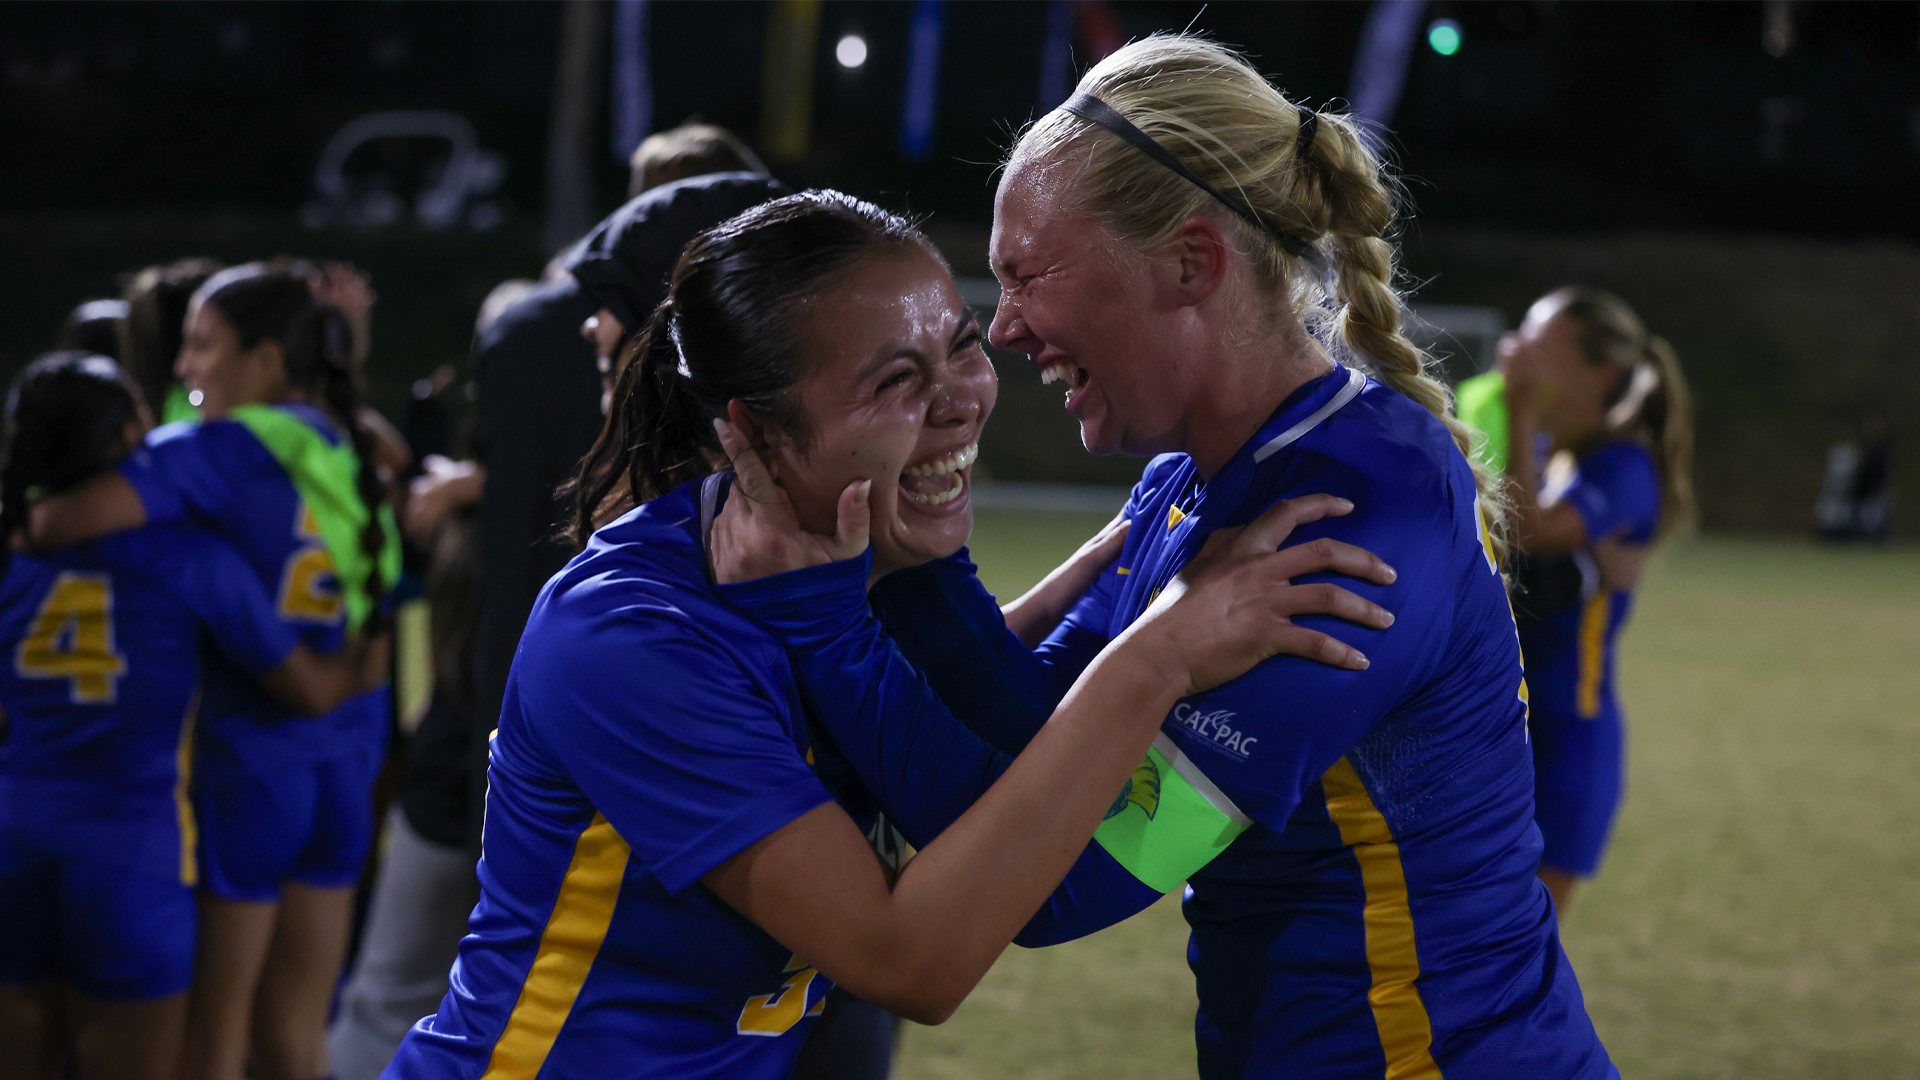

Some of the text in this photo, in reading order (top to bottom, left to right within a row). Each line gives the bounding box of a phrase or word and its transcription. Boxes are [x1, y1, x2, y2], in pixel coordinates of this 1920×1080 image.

[15, 571, 127, 703] 4
[1174, 702, 1258, 756] CAL PAC
